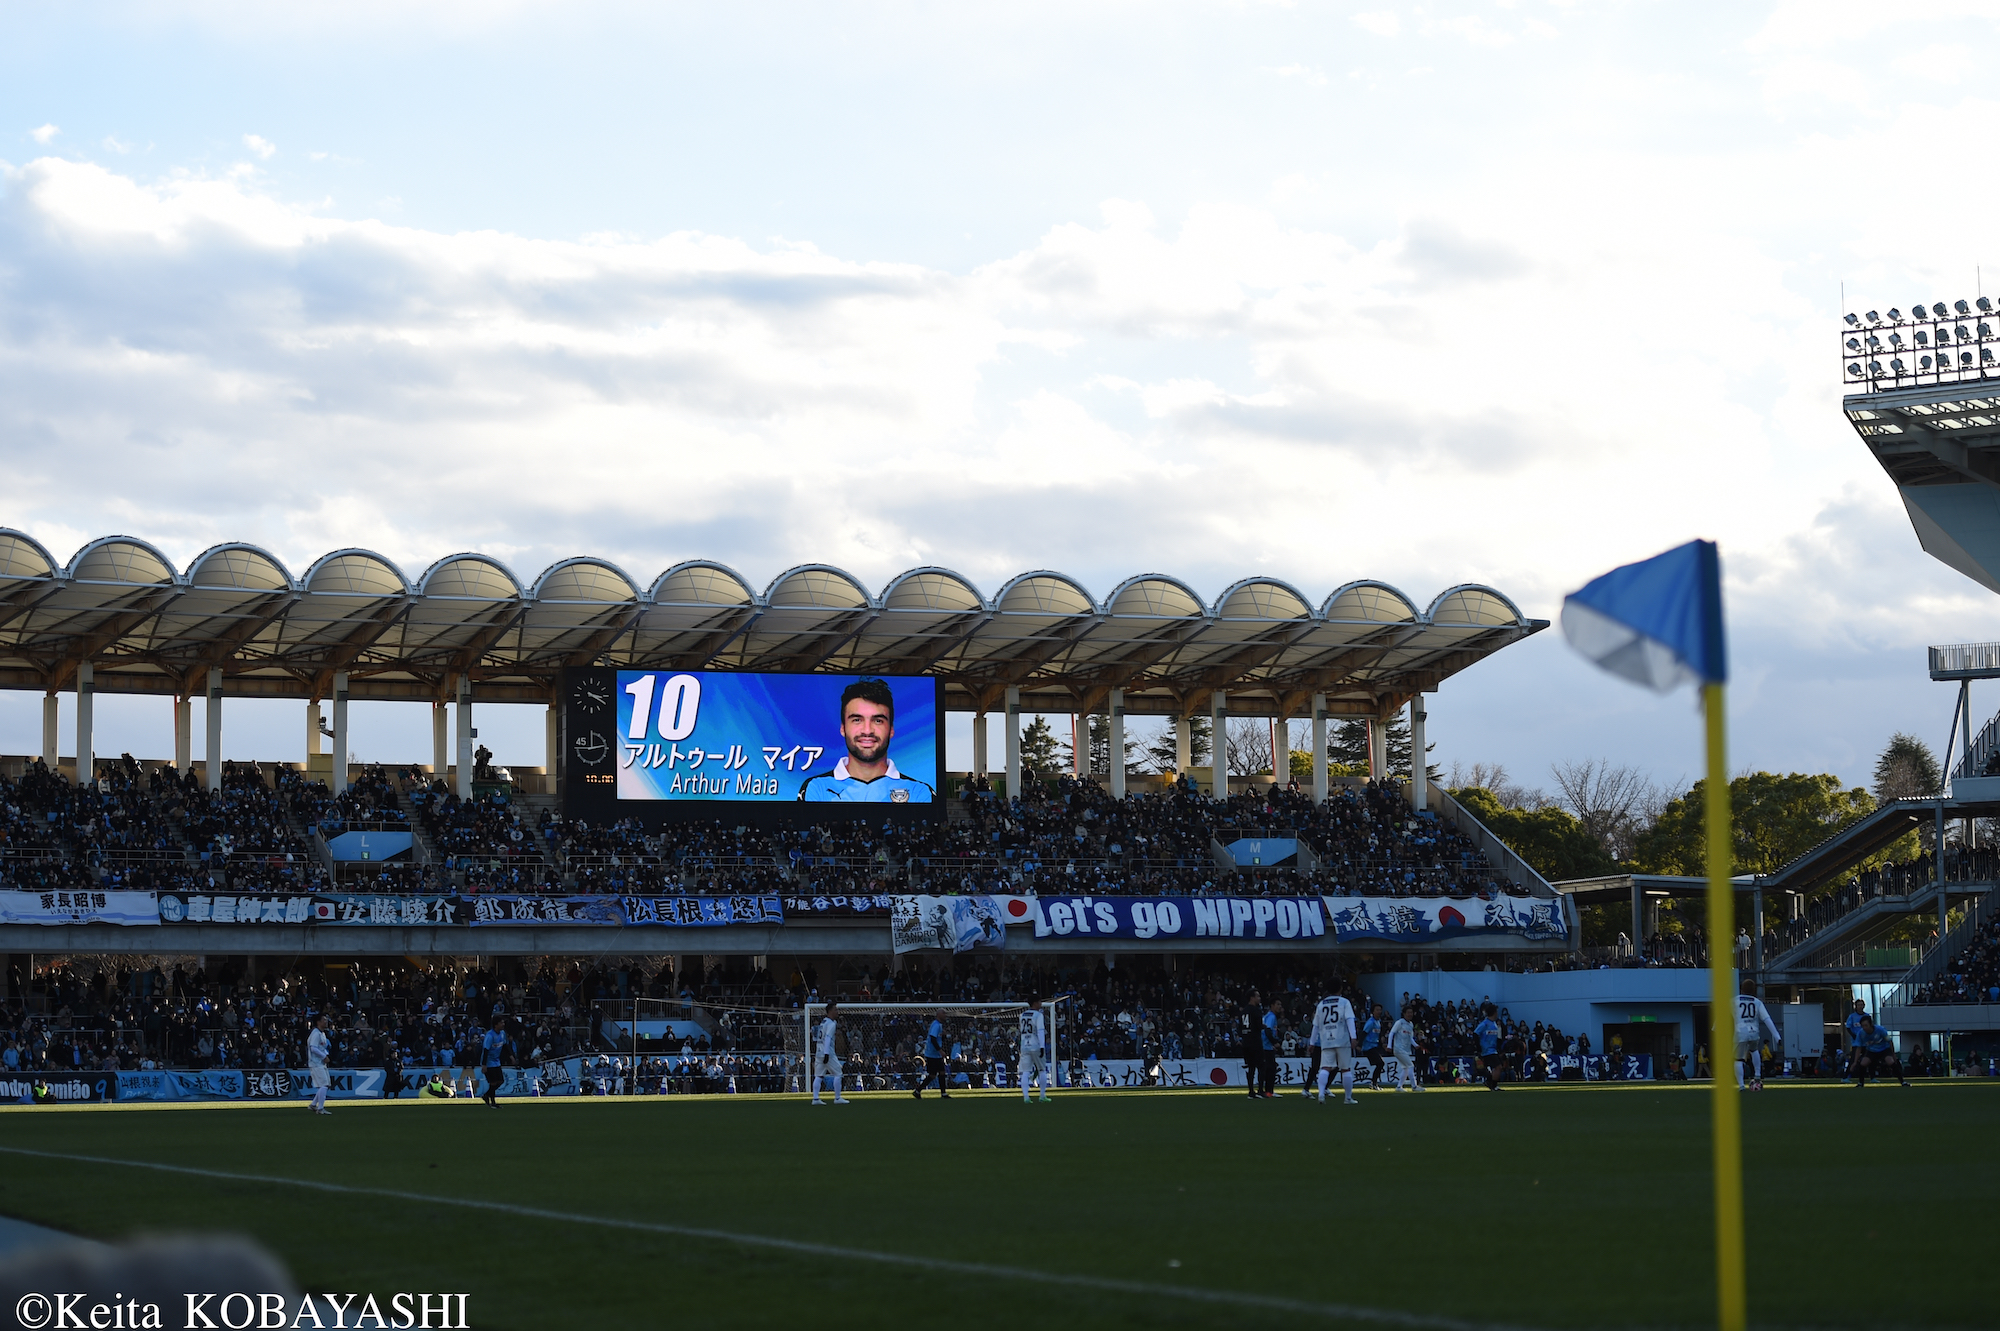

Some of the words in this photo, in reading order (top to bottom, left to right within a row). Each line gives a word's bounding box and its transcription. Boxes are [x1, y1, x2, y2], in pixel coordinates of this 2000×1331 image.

[624, 673, 702, 742] 10
[575, 737, 587, 746] 45
[621, 743, 749, 770] アルトゥール
[761, 745, 824, 772] マイア
[669, 772, 730, 794] Arthur
[735, 773, 779, 795] Maia
[361, 835, 369, 847] L
[1250, 842, 1261, 854] M
[40, 893, 107, 910] 家長昭博
[187, 896, 312, 923] 車屋紳太郎
[337, 899, 457, 925] 安藤駿介
[625, 896, 704, 925] 松長根
[728, 895, 782, 921] 悠仁
[811, 895, 891, 912] 谷口彰悟
[1034, 896, 1119, 938] Let's
[1130, 900, 1182, 939] go
[1192, 898, 1325, 938] NIPPON
[894, 929, 936, 940] LEANDRO
[1322, 1004, 1339, 1025] 25
[1739, 1002, 1756, 1019] 20
[1021, 1018, 1033, 1034] 25
[34, 1079, 90, 1100] amião
[95, 1079, 107, 1100] 9
